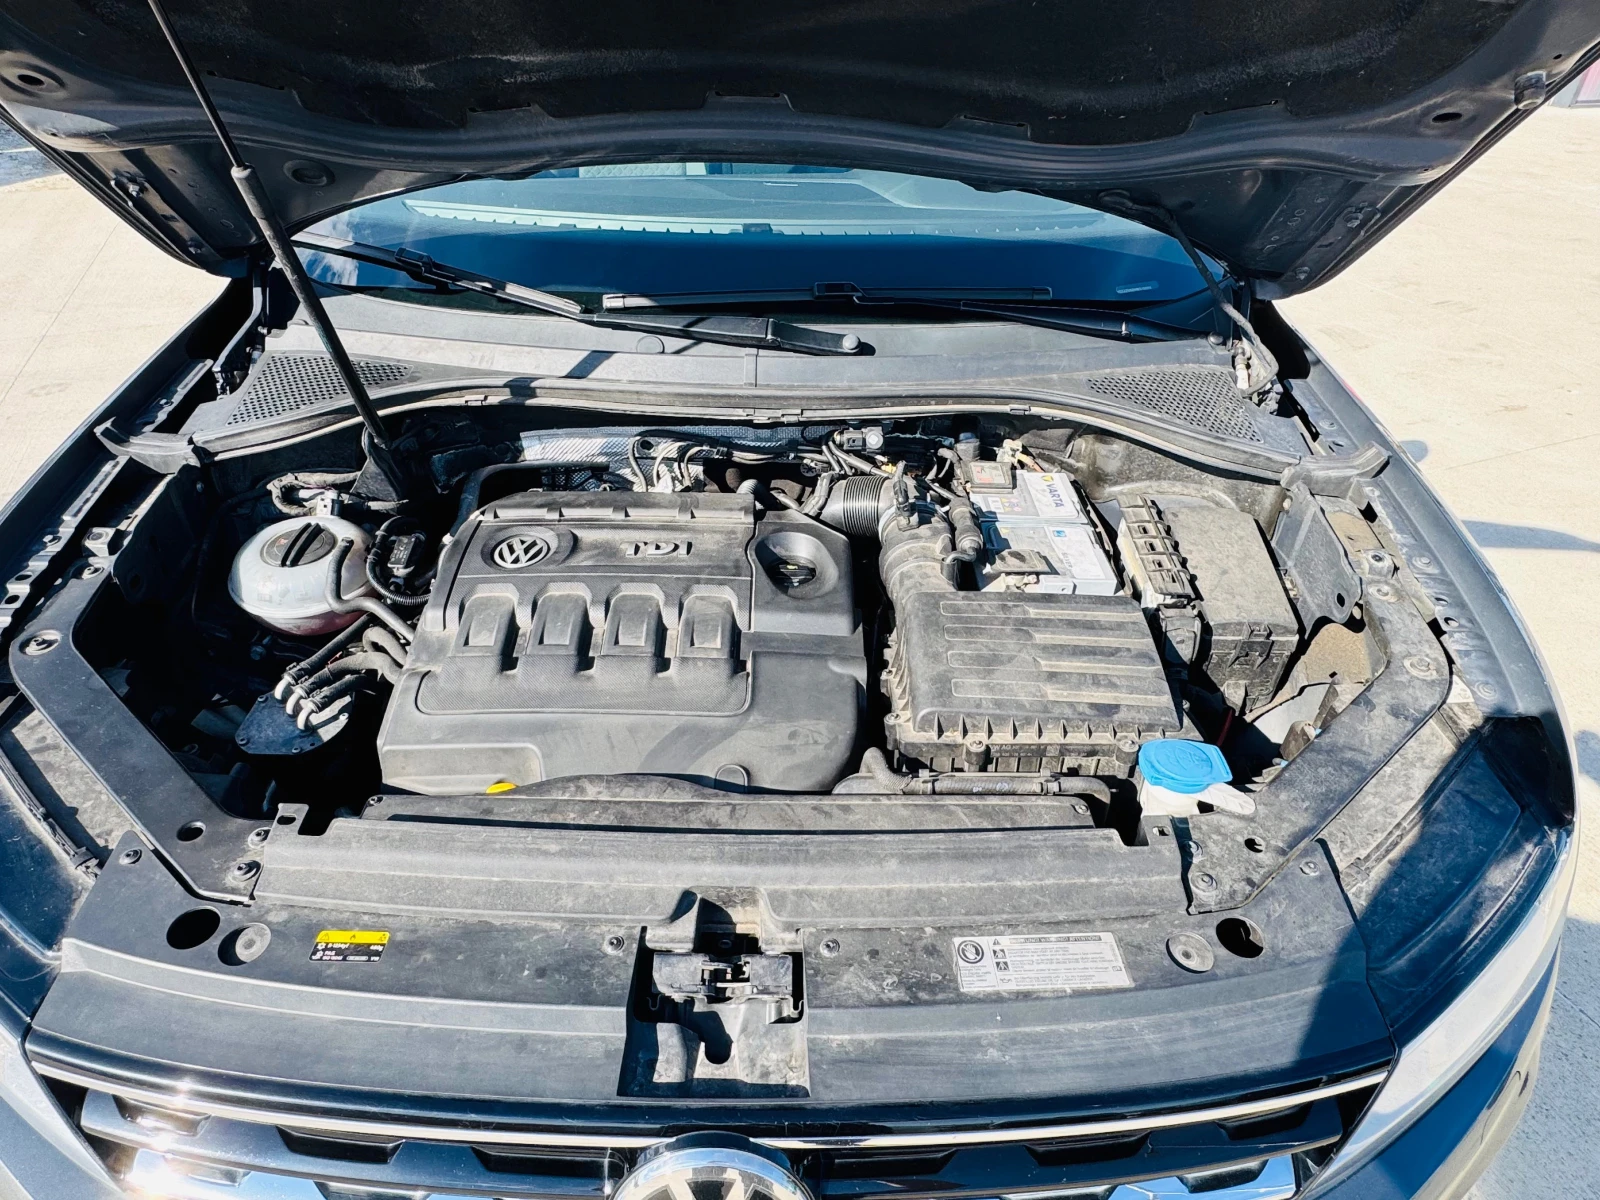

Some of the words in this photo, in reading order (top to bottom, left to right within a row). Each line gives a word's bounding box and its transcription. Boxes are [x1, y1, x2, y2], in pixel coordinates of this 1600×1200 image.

[1046, 483, 1065, 508] VARTA
[494, 535, 550, 569] VW
[620, 540, 693, 558] TDI
